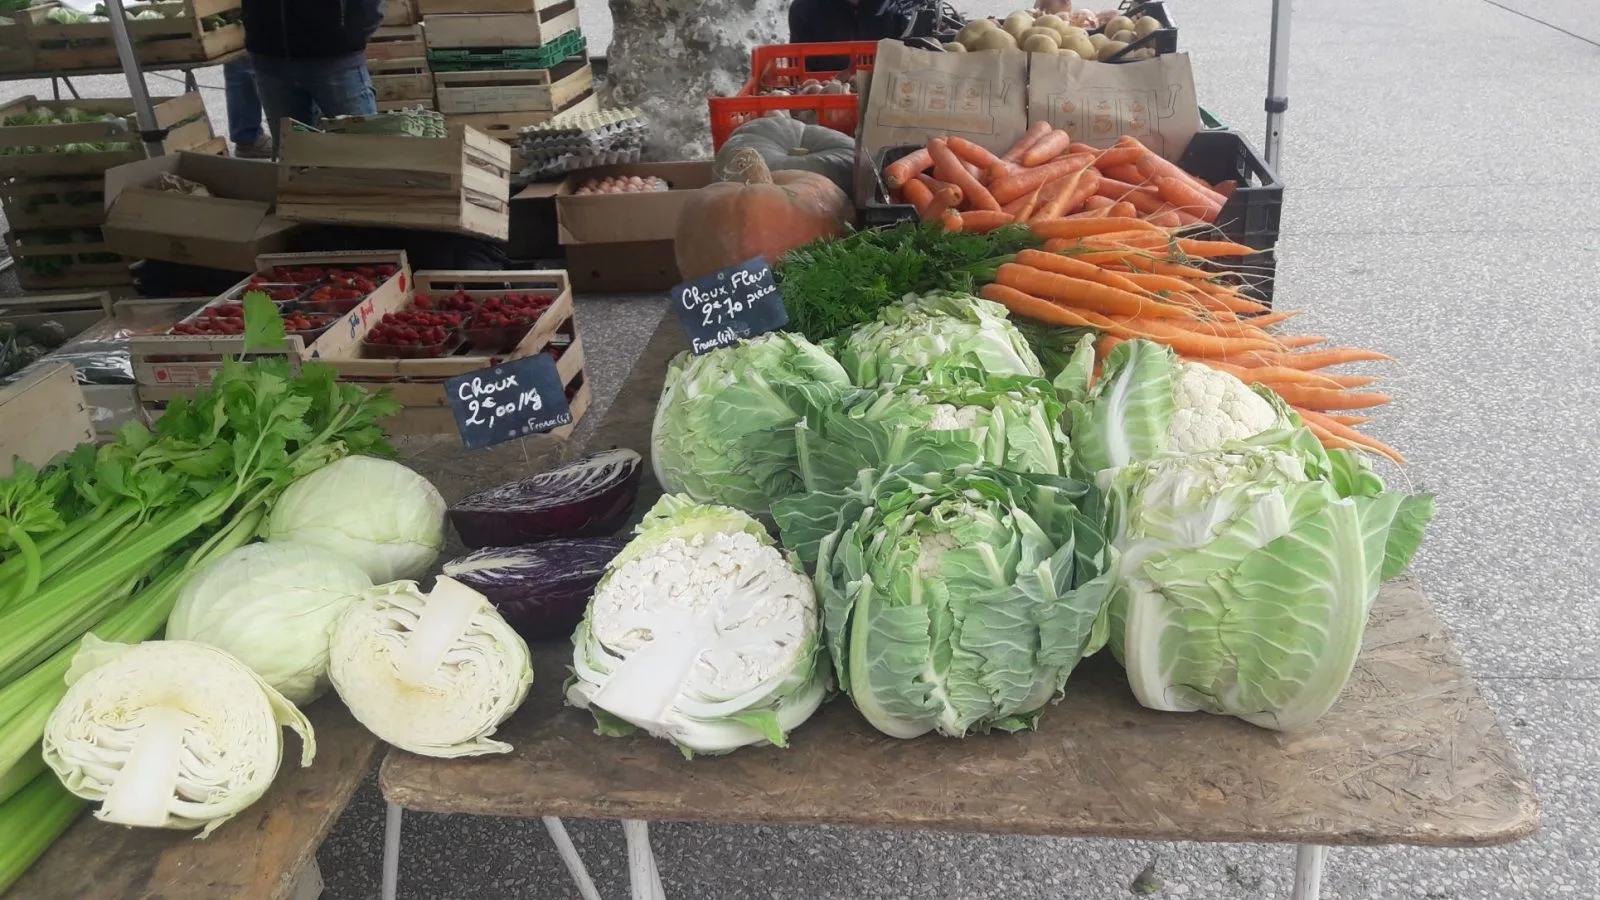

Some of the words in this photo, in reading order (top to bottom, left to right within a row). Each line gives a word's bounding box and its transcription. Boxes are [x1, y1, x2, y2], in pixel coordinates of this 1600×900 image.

[682, 286, 728, 310] Choux
[731, 268, 768, 289] Fleur
[459, 375, 519, 400] Choux
